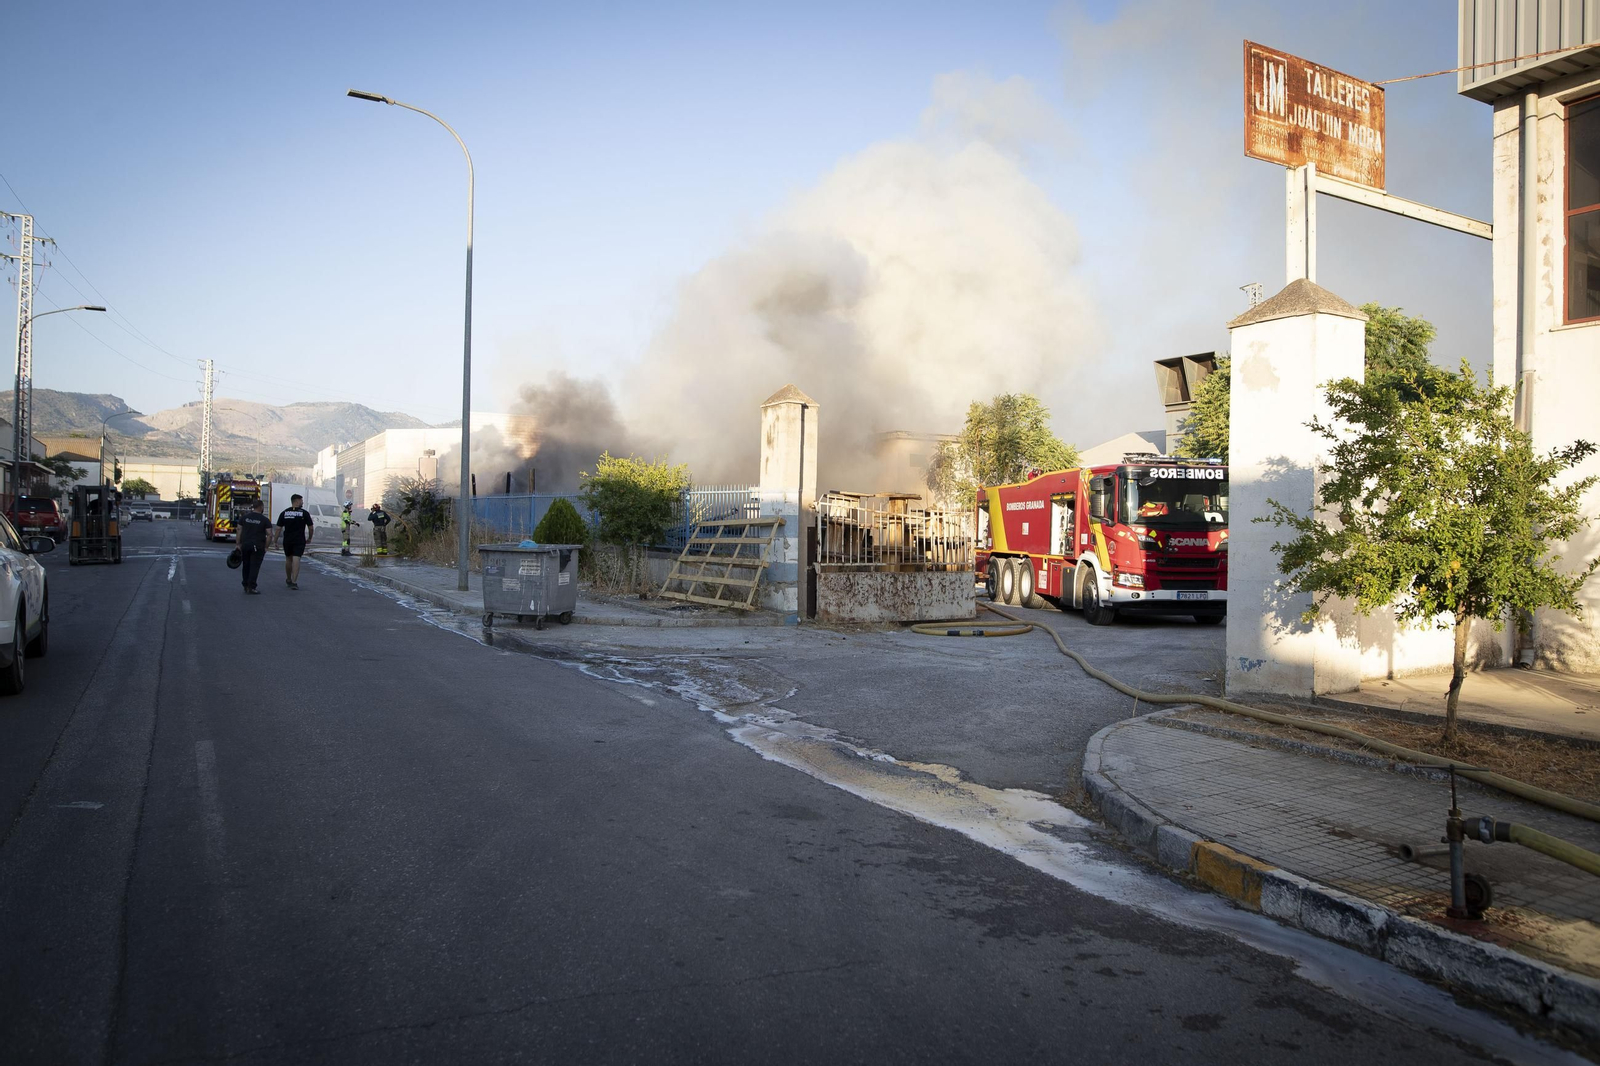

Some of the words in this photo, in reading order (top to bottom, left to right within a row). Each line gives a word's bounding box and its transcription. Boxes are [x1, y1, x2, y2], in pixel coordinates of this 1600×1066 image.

[1255, 59, 1285, 117] JM
[1348, 121, 1382, 154] MORA
[1006, 502, 1026, 511] BOMBEROS
[1026, 499, 1045, 510] GRANADA
[1169, 537, 1211, 547] SCANIA
